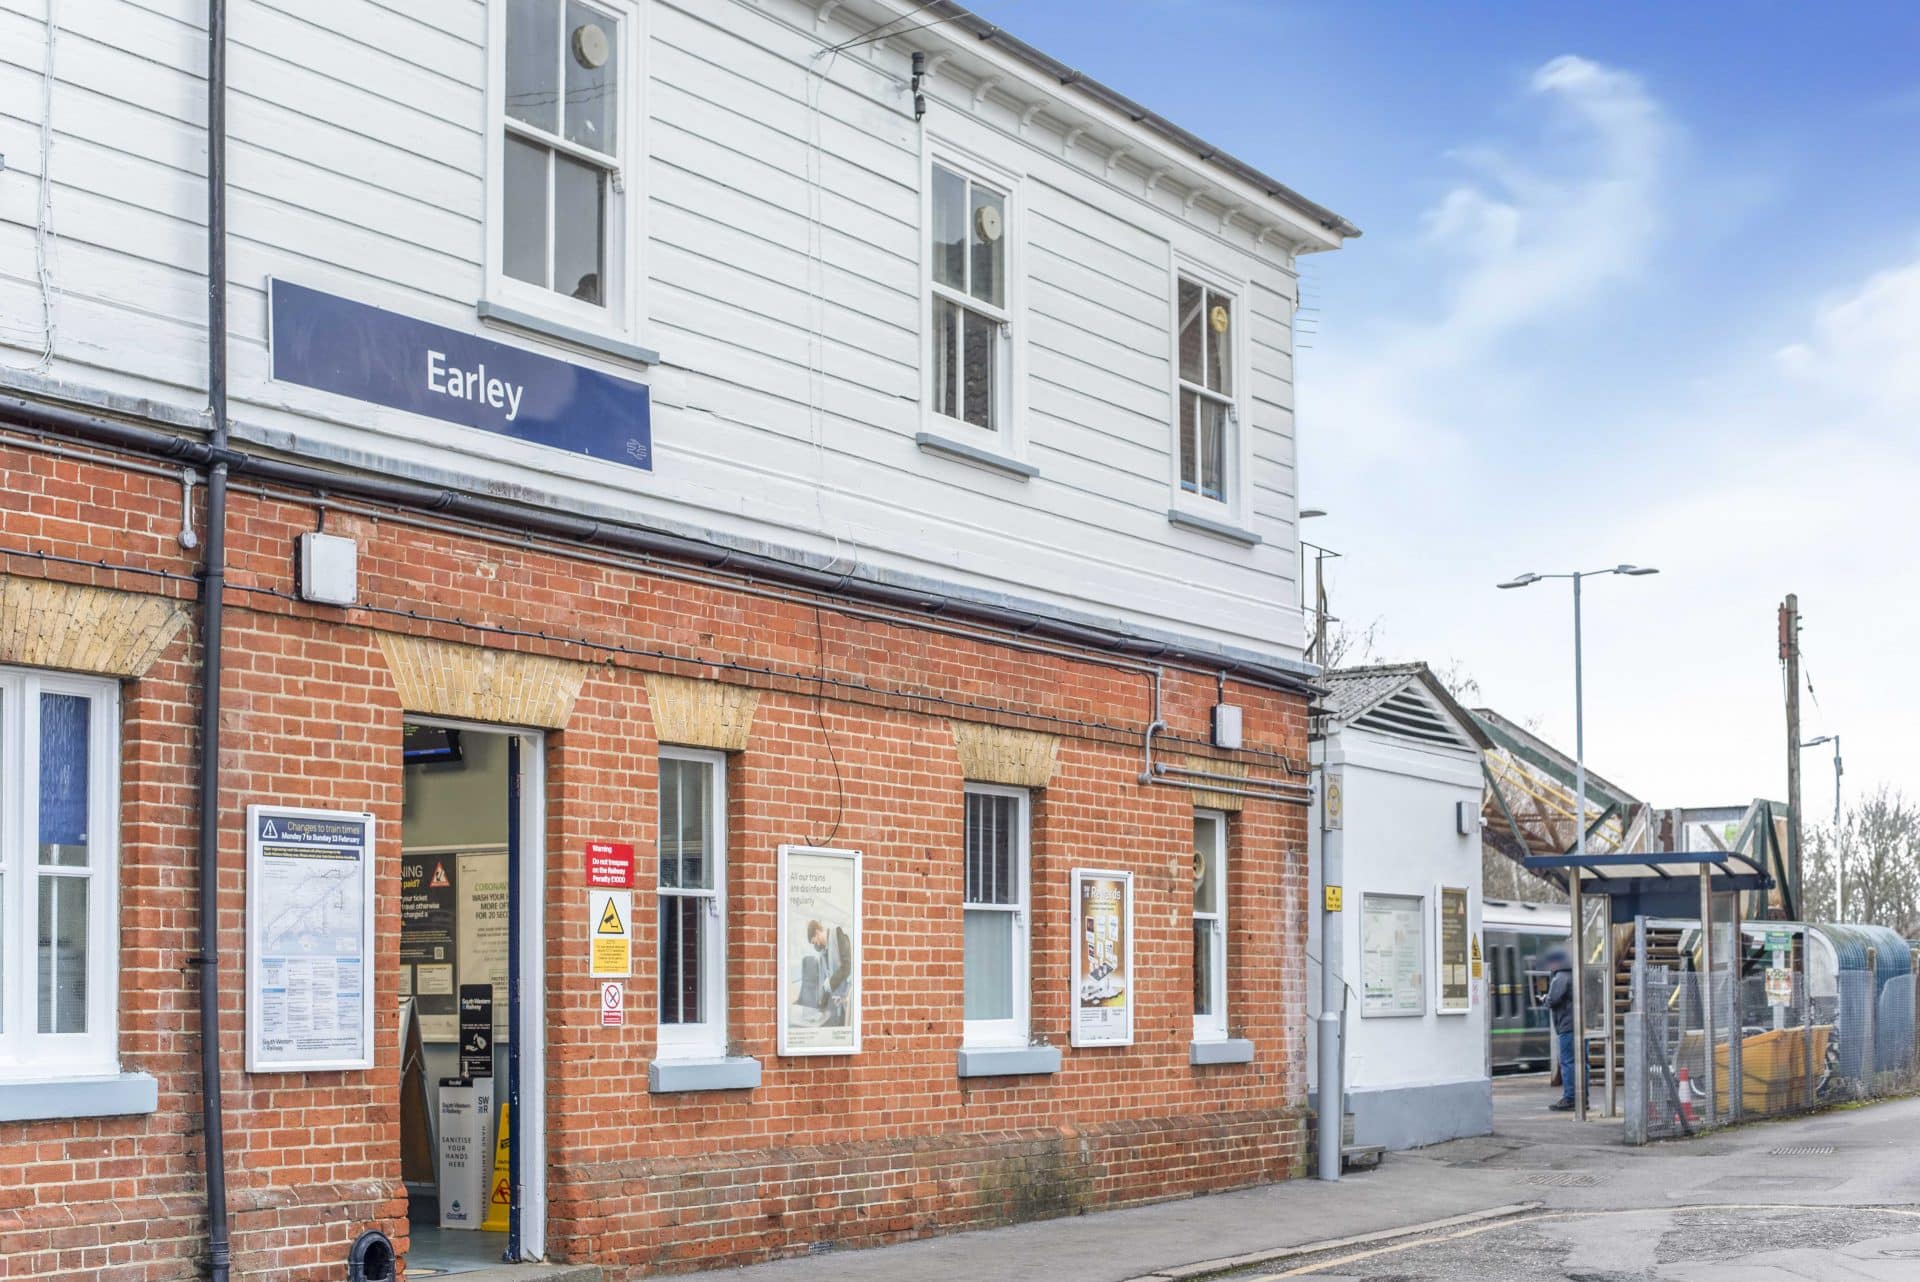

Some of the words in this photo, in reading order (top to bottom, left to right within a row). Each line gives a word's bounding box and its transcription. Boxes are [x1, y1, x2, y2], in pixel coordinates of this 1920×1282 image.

[427, 350, 523, 421] Earley
[288, 821, 317, 833] Changes
[318, 824, 325, 832] to
[326, 824, 341, 833] train
[342, 825, 360, 834] times
[281, 832, 302, 842] Monday
[339, 835, 360, 844] February
[592, 845, 613, 854] Warning
[592, 857, 599, 865] Do
[609, 859, 629, 867] trespass
[608, 867, 626, 875] Railway
[592, 875, 611, 884] Penalty
[809, 872, 826, 881] trains
[800, 884, 832, 893] disinfected
[472, 894, 489, 902] WASH
[490, 893, 505, 901] YOUR
[790, 896, 815, 907] regularly
[480, 902, 497, 910] MORE
[475, 911, 486, 920] FOR
[488, 911, 496, 919] 20
[478, 1096, 489, 1105] SW
[441, 1136, 472, 1144] SANITISE
